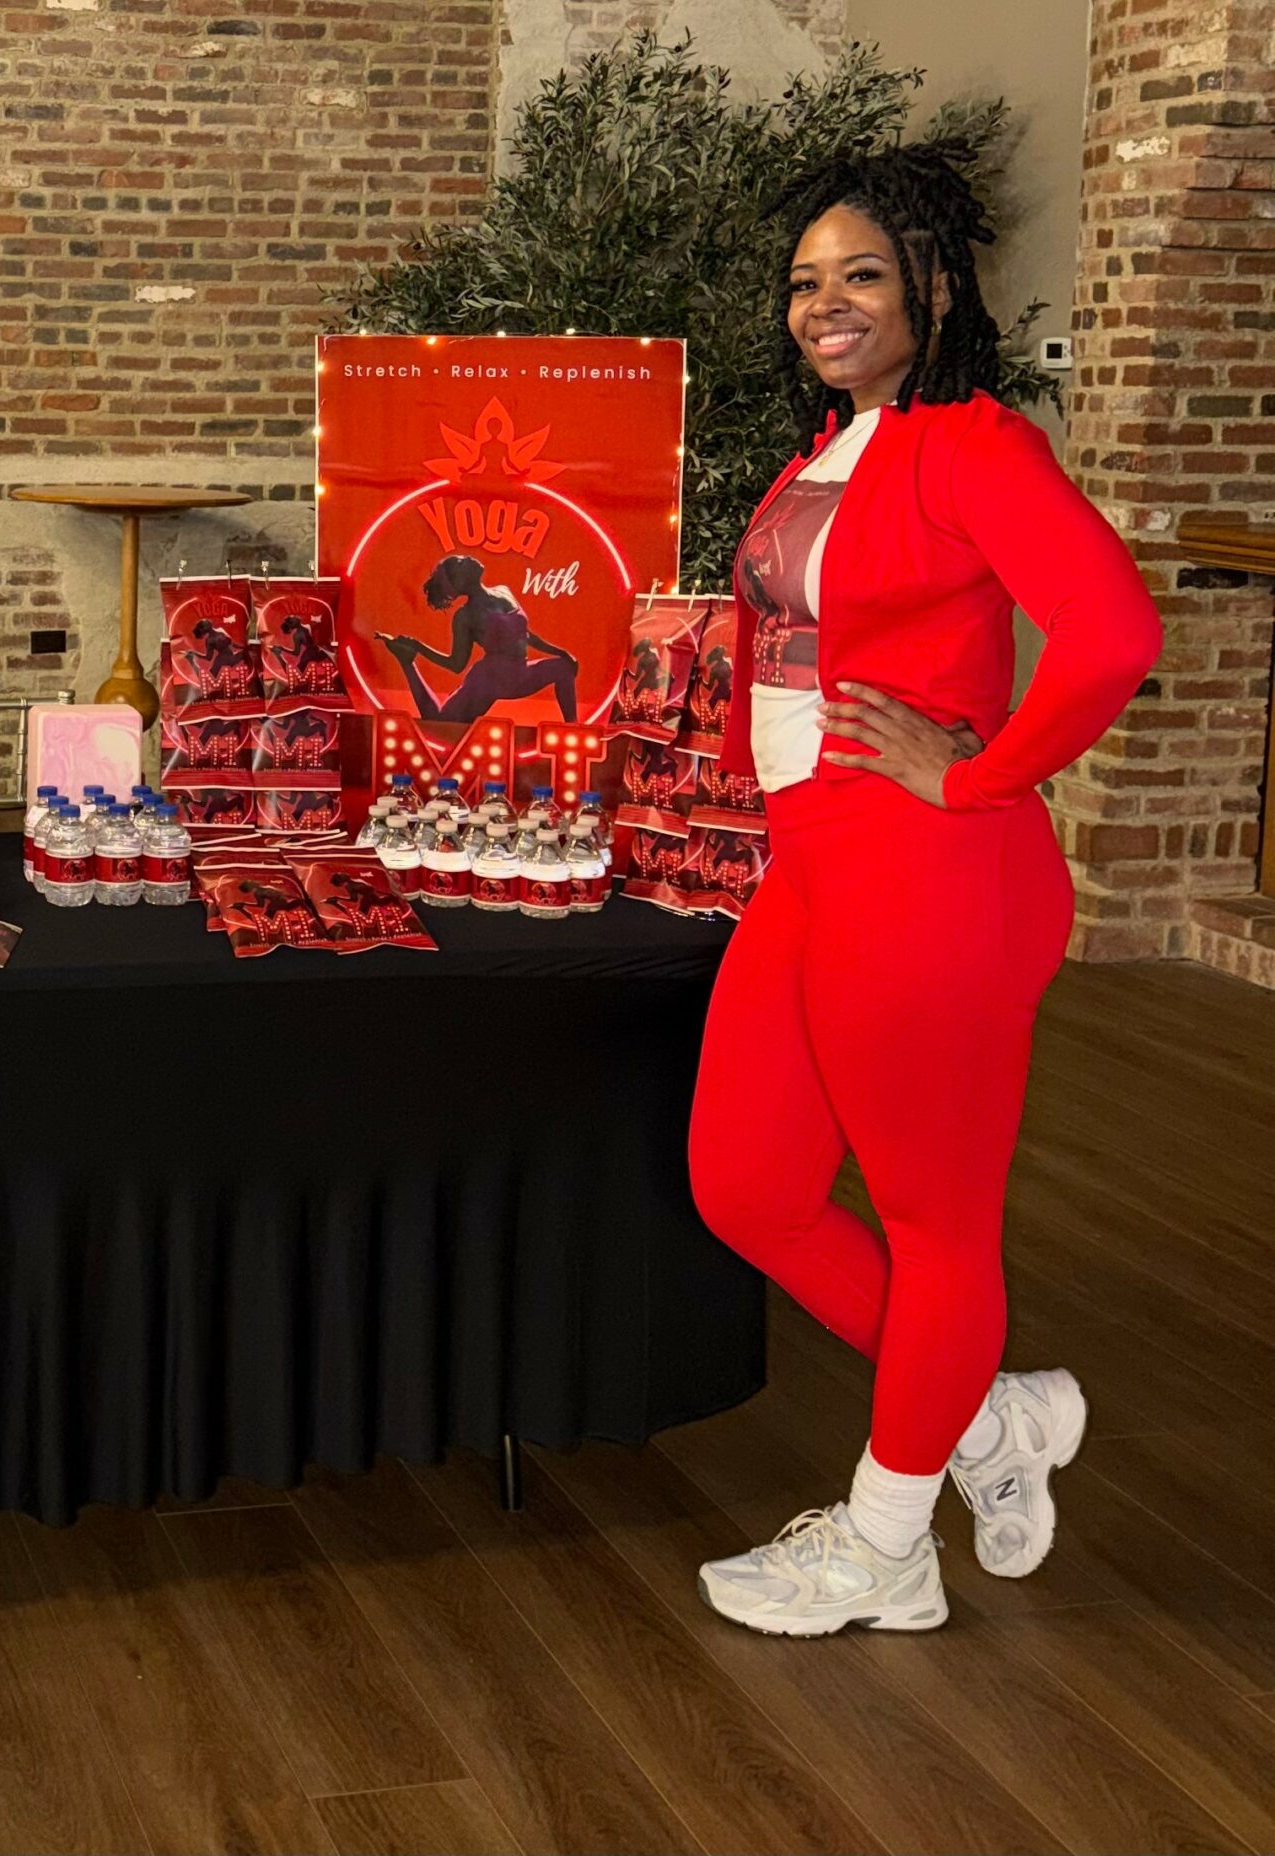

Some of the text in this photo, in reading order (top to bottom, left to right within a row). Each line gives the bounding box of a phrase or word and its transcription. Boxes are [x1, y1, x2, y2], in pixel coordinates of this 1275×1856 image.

[343, 364, 651, 382] Stretch Relax Replenish
[417, 495, 551, 560] Yoga
[521, 560, 581, 597] With
[993, 1476, 1018, 1501] N
